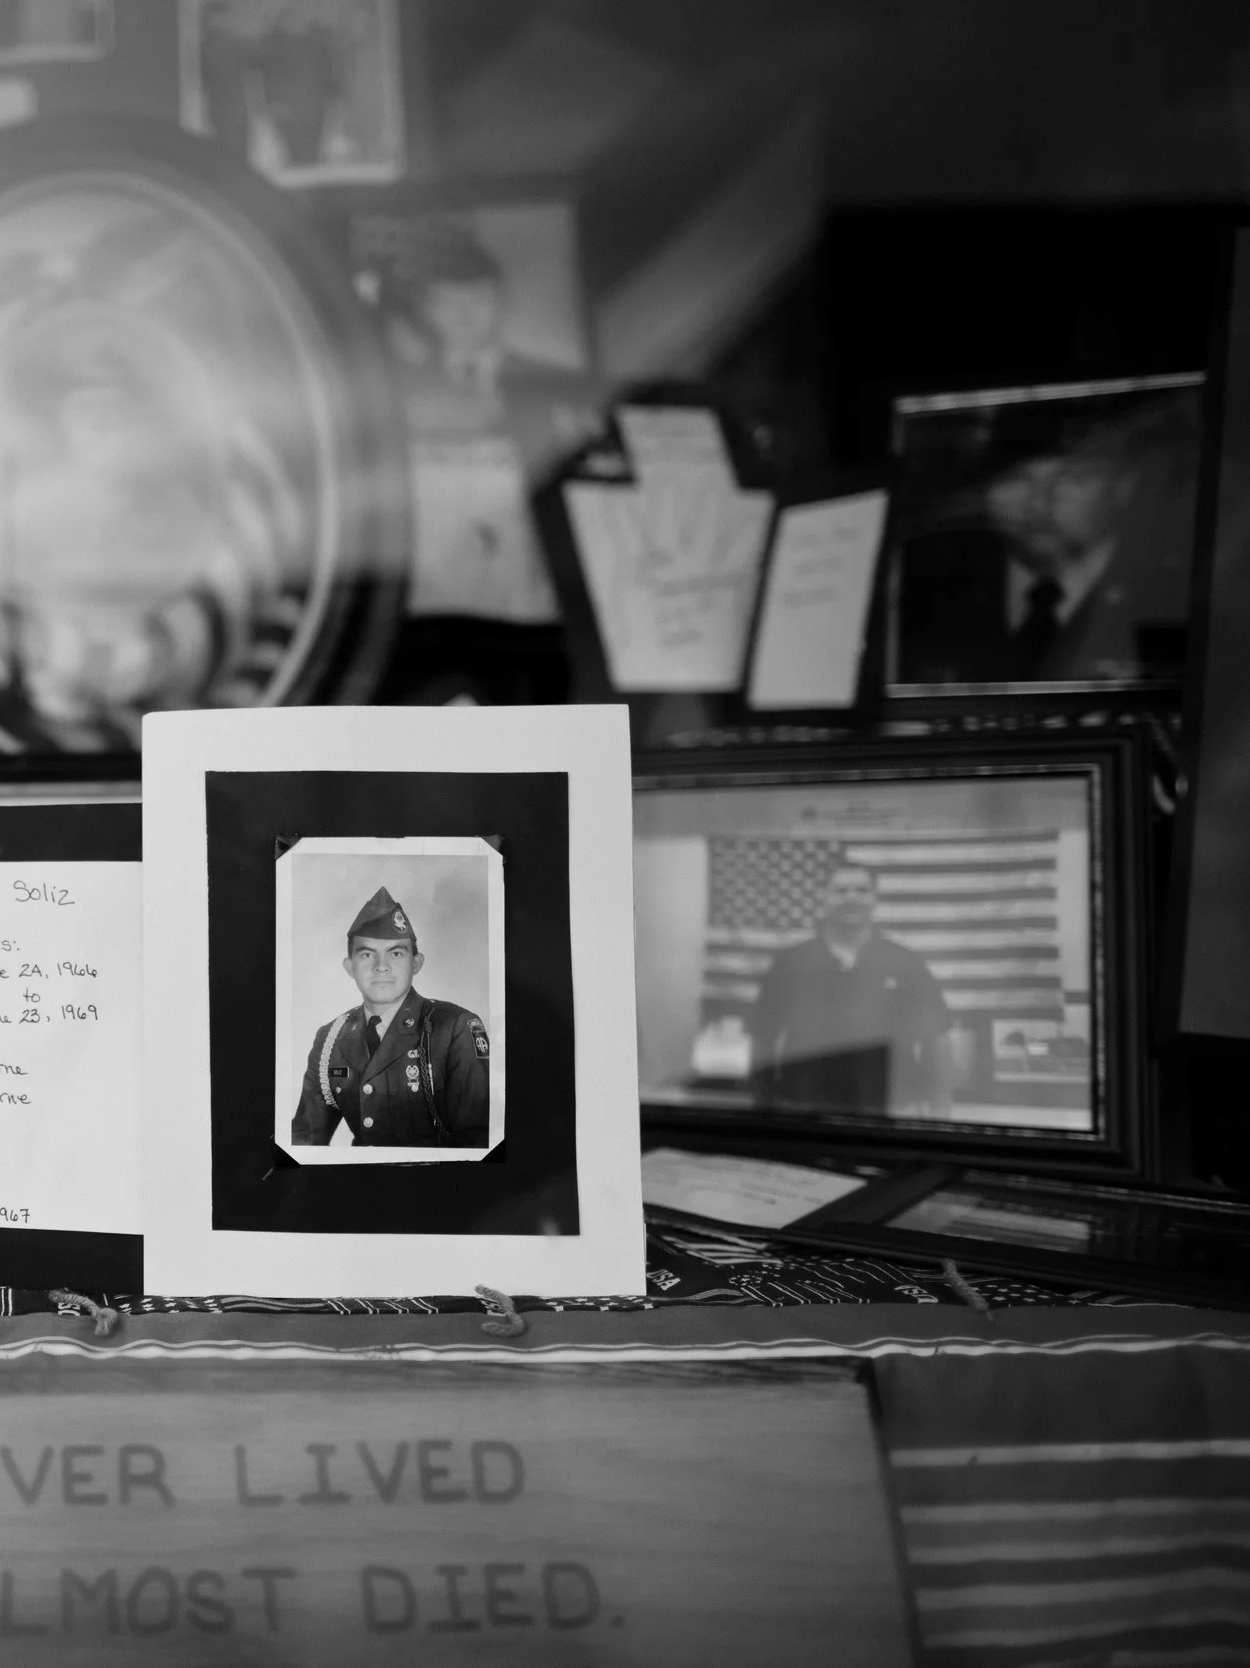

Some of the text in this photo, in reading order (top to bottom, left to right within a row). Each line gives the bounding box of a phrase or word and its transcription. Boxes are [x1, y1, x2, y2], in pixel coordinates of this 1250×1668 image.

[13, 880, 76, 906] Soliz
[56, 961, 98, 978] 1966
[23, 987, 41, 1003] to
[61, 1004, 99, 1021] 1969
[234, 1439, 525, 1506] LIVED
[360, 1561, 626, 1634] DIED.
